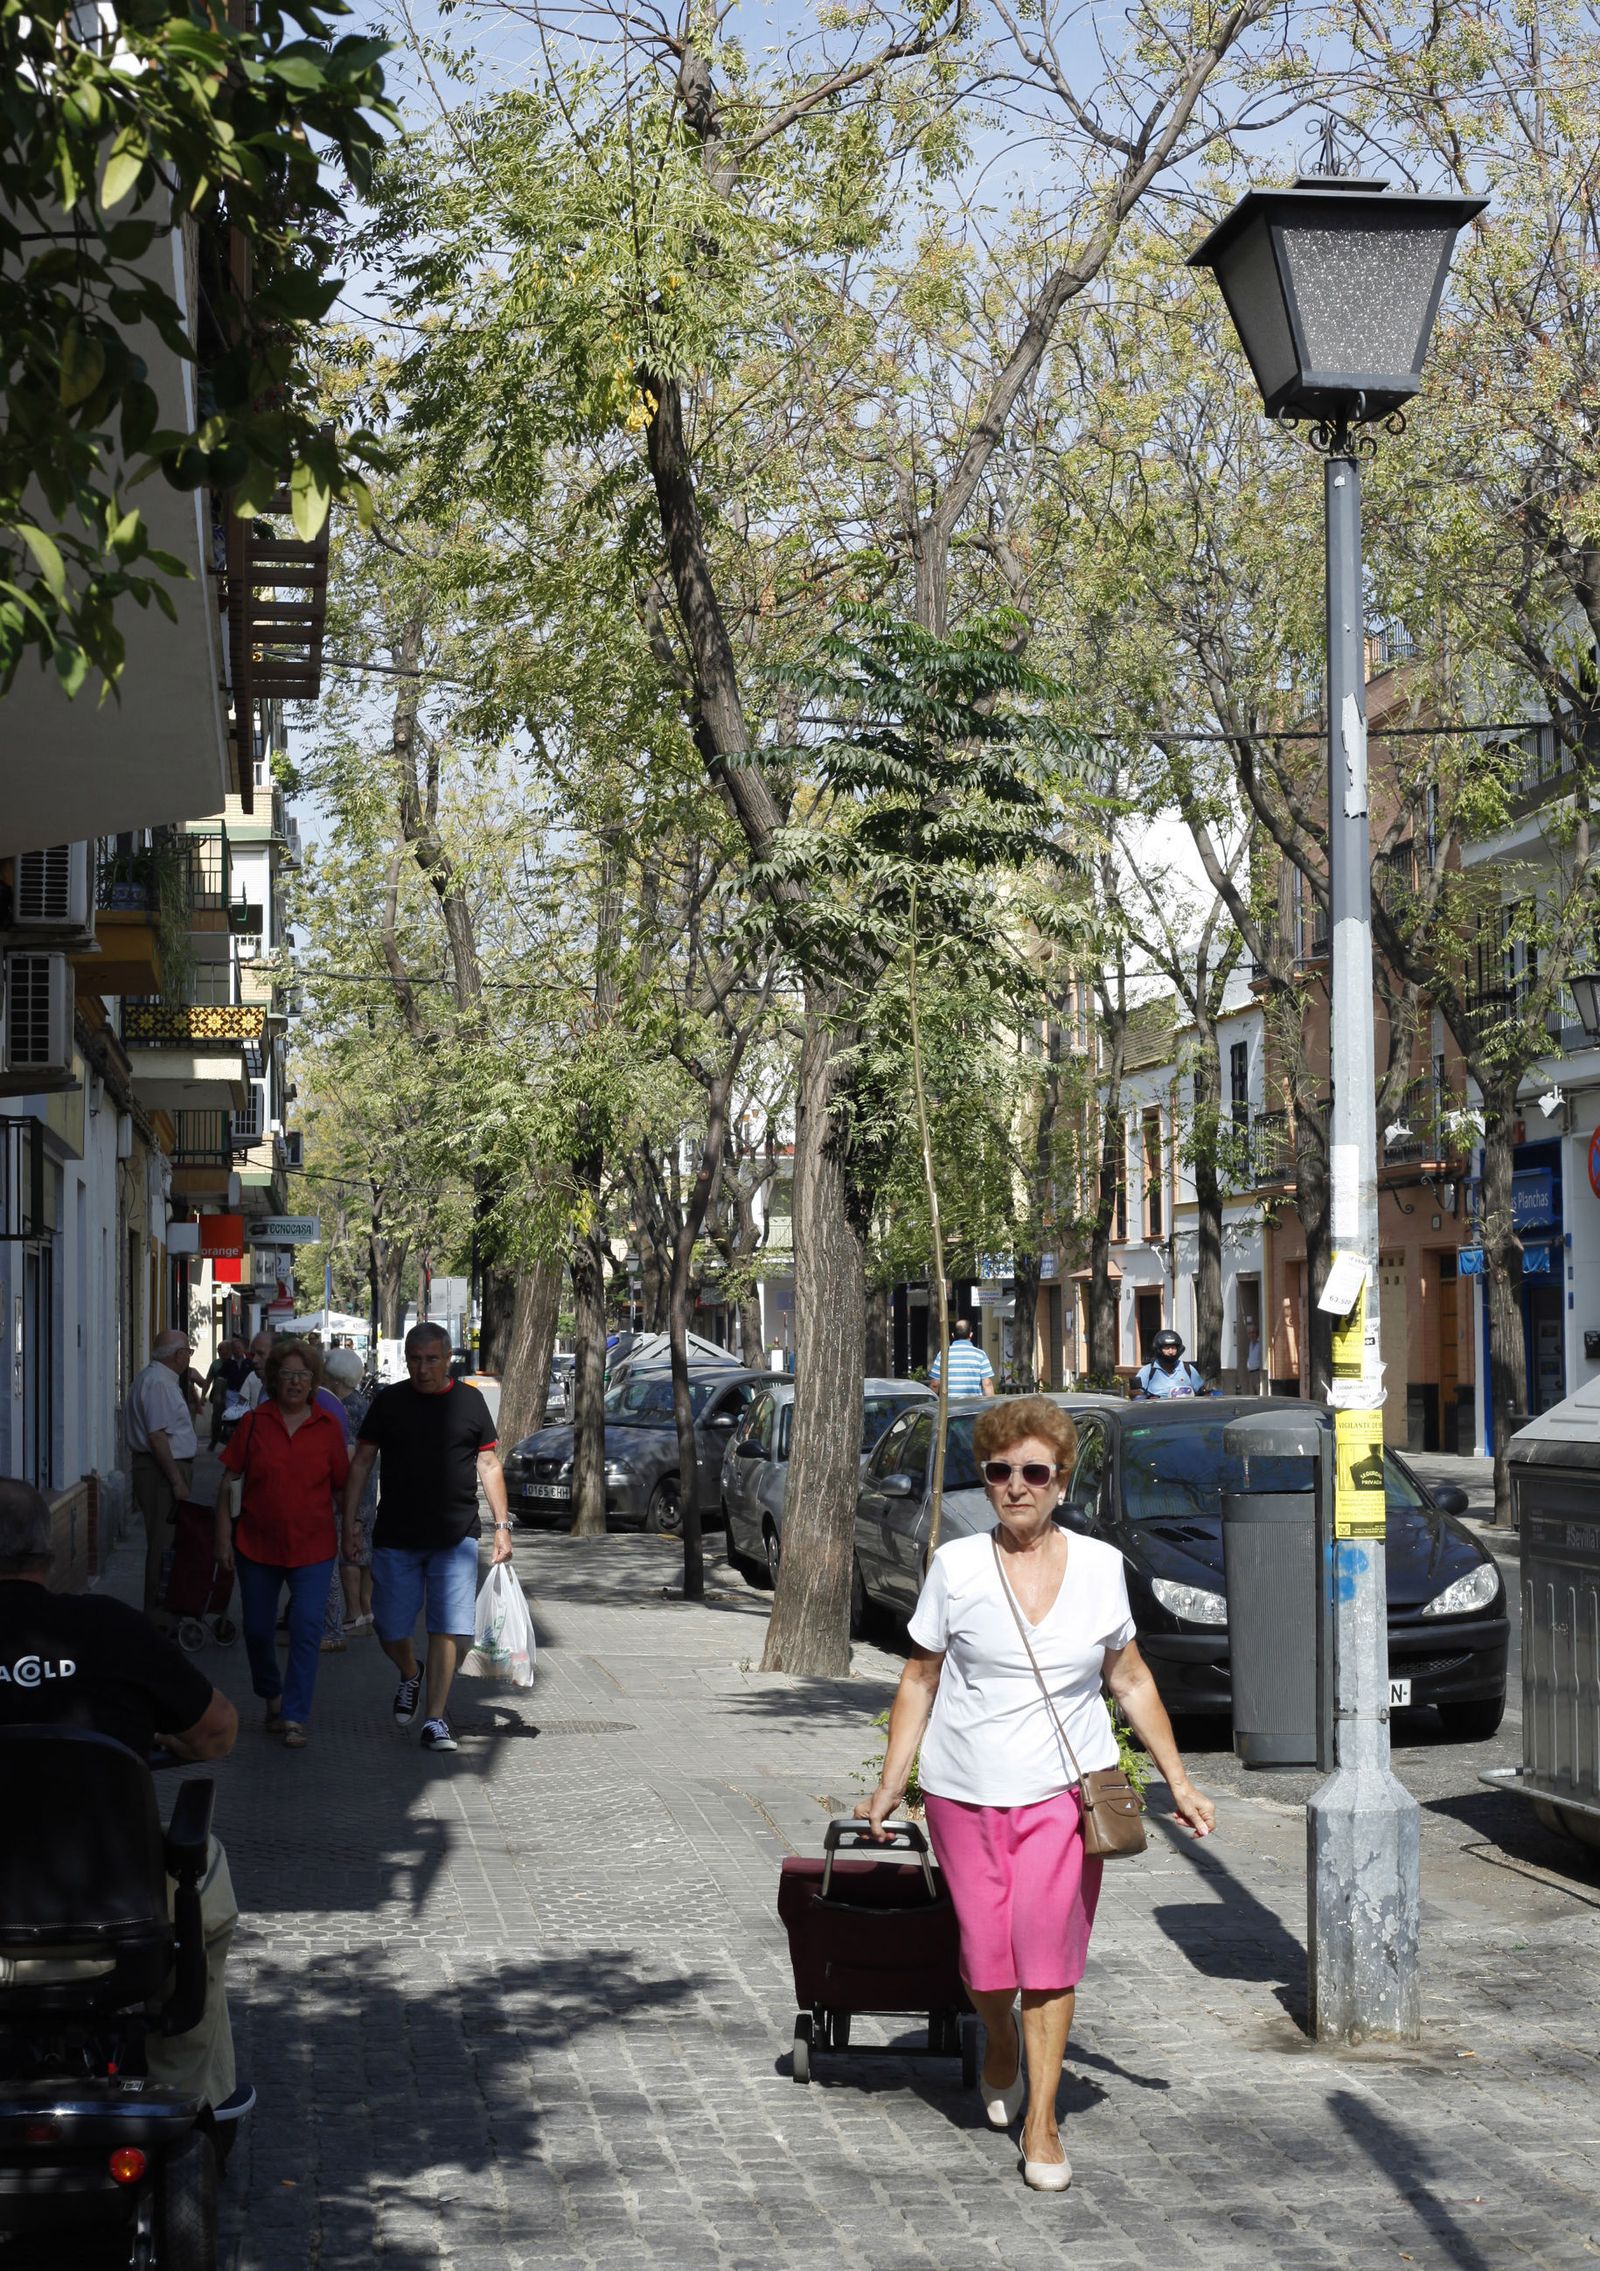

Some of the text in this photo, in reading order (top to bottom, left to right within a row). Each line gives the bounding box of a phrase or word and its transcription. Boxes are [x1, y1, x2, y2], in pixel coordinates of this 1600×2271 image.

[1518, 1189, 1549, 1209] Planchas
[201, 1246, 240, 1258] orange
[1566, 1523, 1600, 1550] #SevillaT
